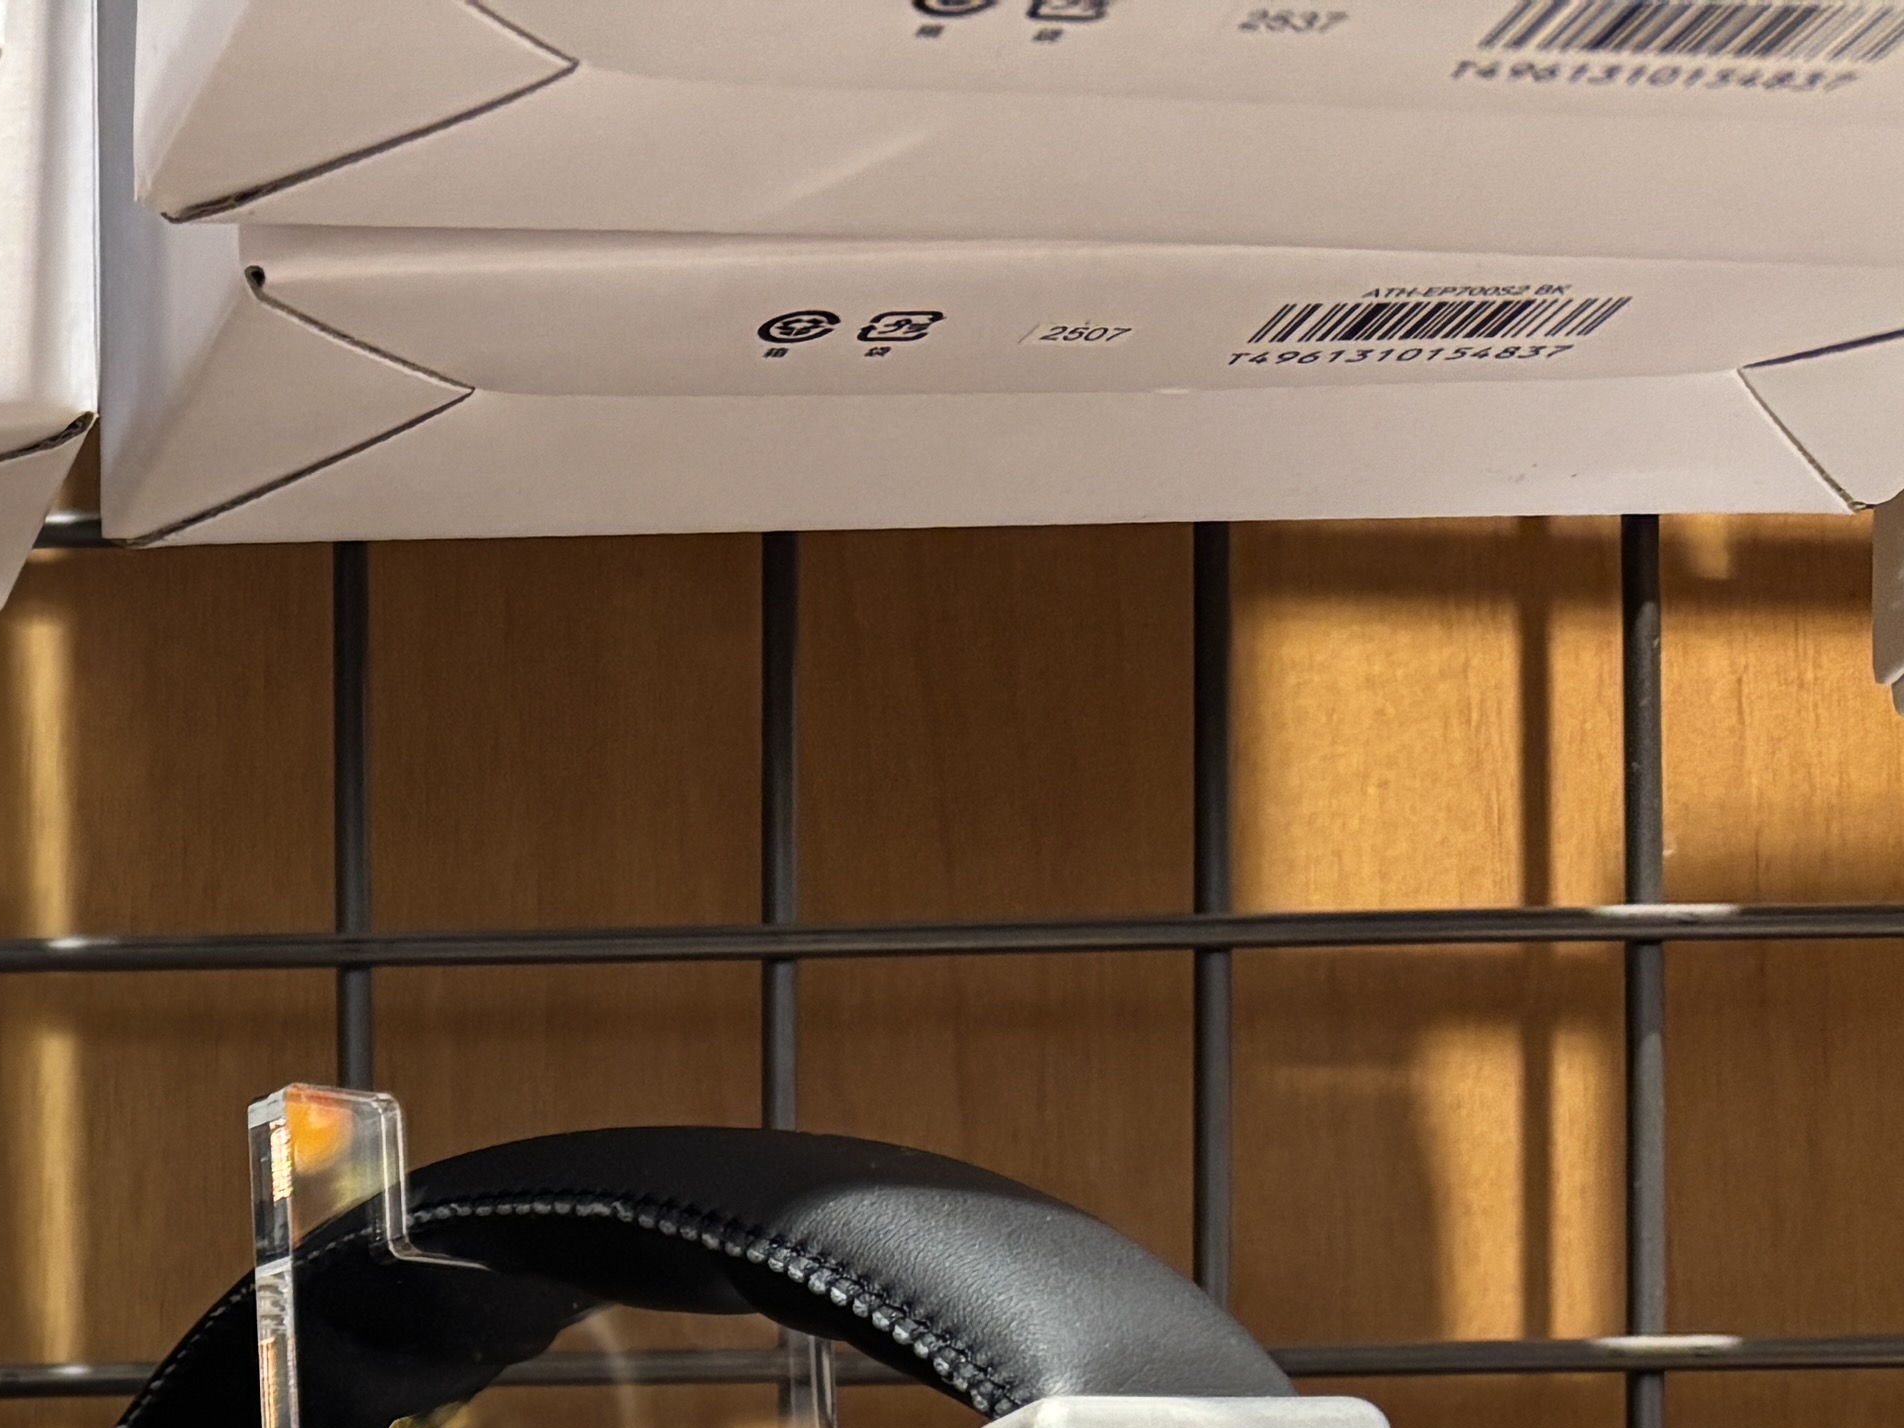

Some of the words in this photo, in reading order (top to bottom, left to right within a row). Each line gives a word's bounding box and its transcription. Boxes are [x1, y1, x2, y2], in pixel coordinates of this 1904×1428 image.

[1363, 284, 1530, 299] ATH-EP700S2
[1534, 283, 1572, 296] BK
[1039, 324, 1133, 343] 2507
[1228, 343, 1574, 366] T4961310154837
